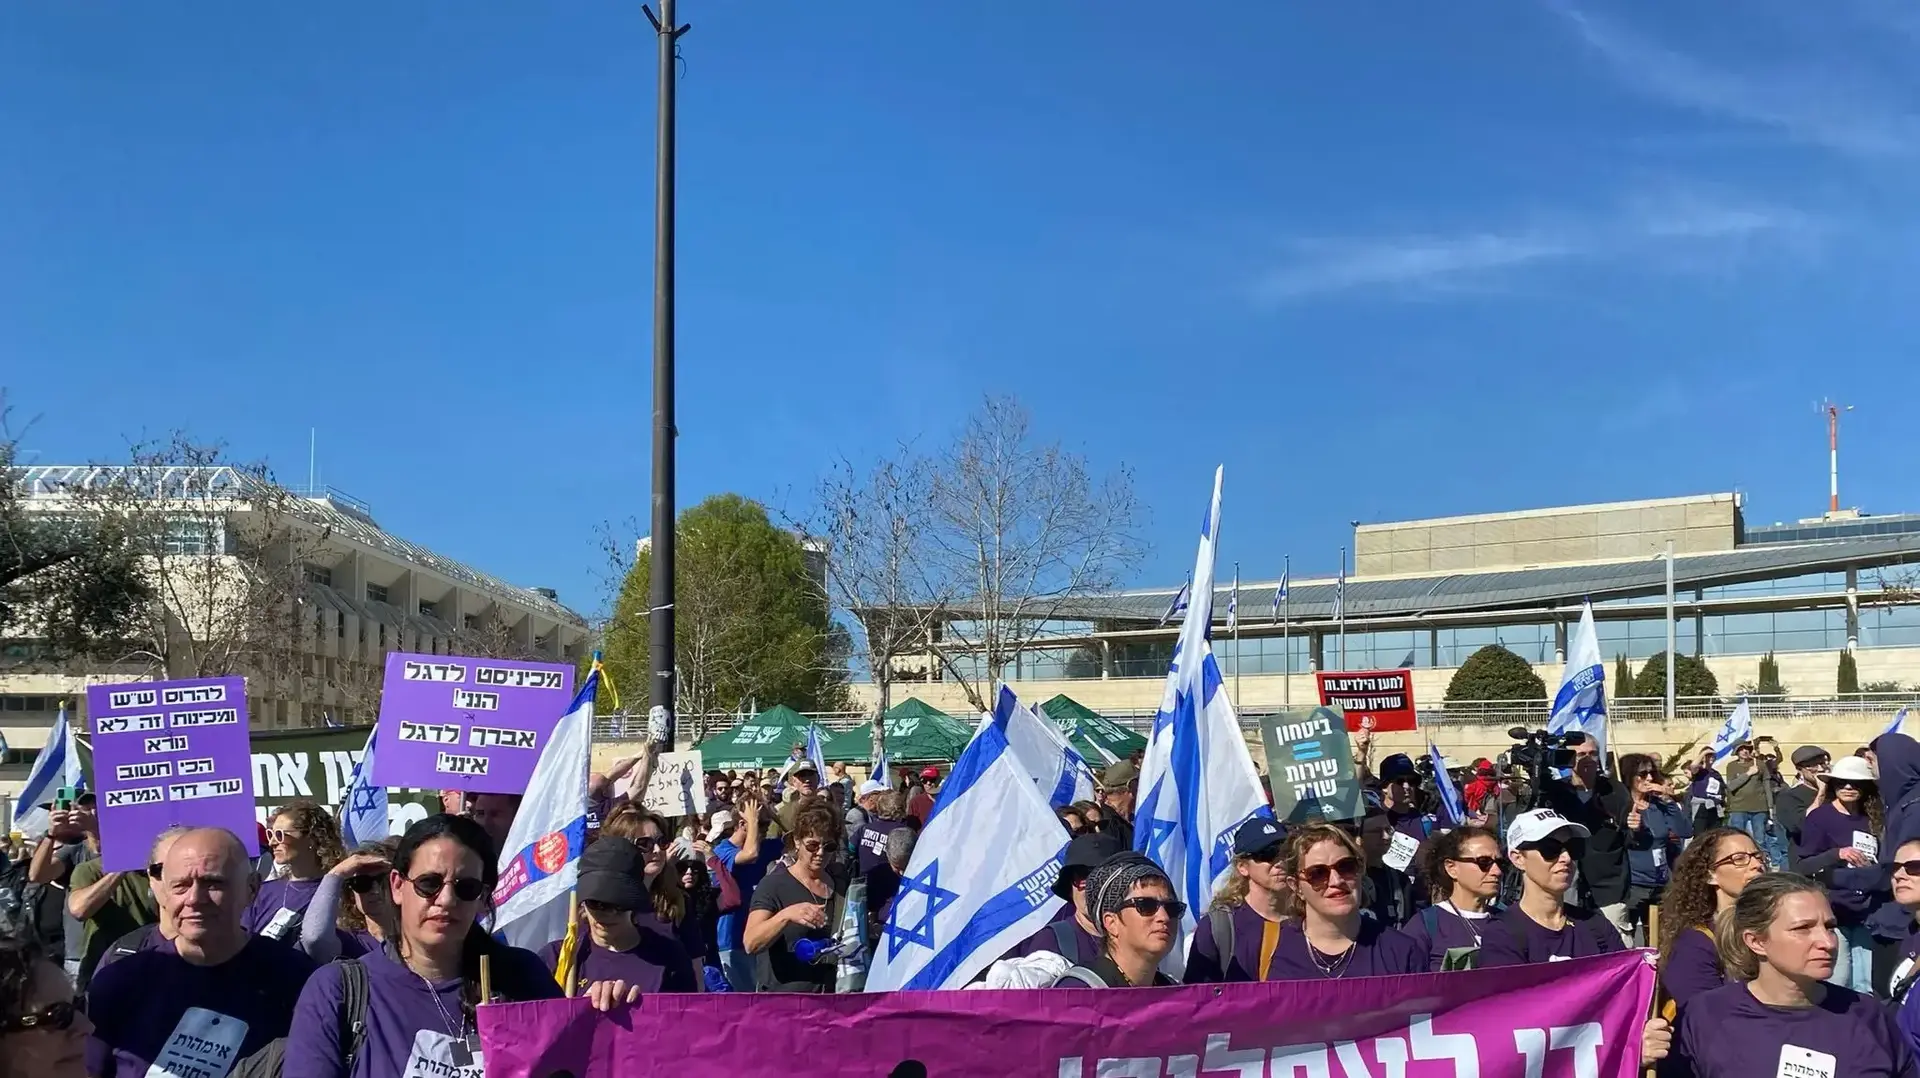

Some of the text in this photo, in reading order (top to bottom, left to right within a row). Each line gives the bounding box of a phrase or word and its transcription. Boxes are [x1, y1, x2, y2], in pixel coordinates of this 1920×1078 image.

[406, 662, 562, 688] מכיניסט לדגל
[1324, 676, 1404, 691] למען הילדים.ות
[165, 687, 223, 704] להרוס
[454, 690, 498, 709] הנני!
[1367, 696, 1402, 710] שוויון
[100, 710, 236, 732] ומכינות זה לא
[1275, 718, 1333, 746] ביטחון
[147, 737, 187, 752] נורא
[402, 722, 535, 748] אברך לדגל
[119, 759, 212, 779] הכי חשוב
[437, 753, 488, 773] אינני!
[1284, 758, 1339, 783] שירות
[108, 780, 241, 805] עוד דף גמרא
[1293, 779, 1338, 801] שווה
[1016, 858, 1063, 893] חופשי
[172, 1033, 232, 1060] אימהות
[1783, 1061, 1829, 1078] אימהות
